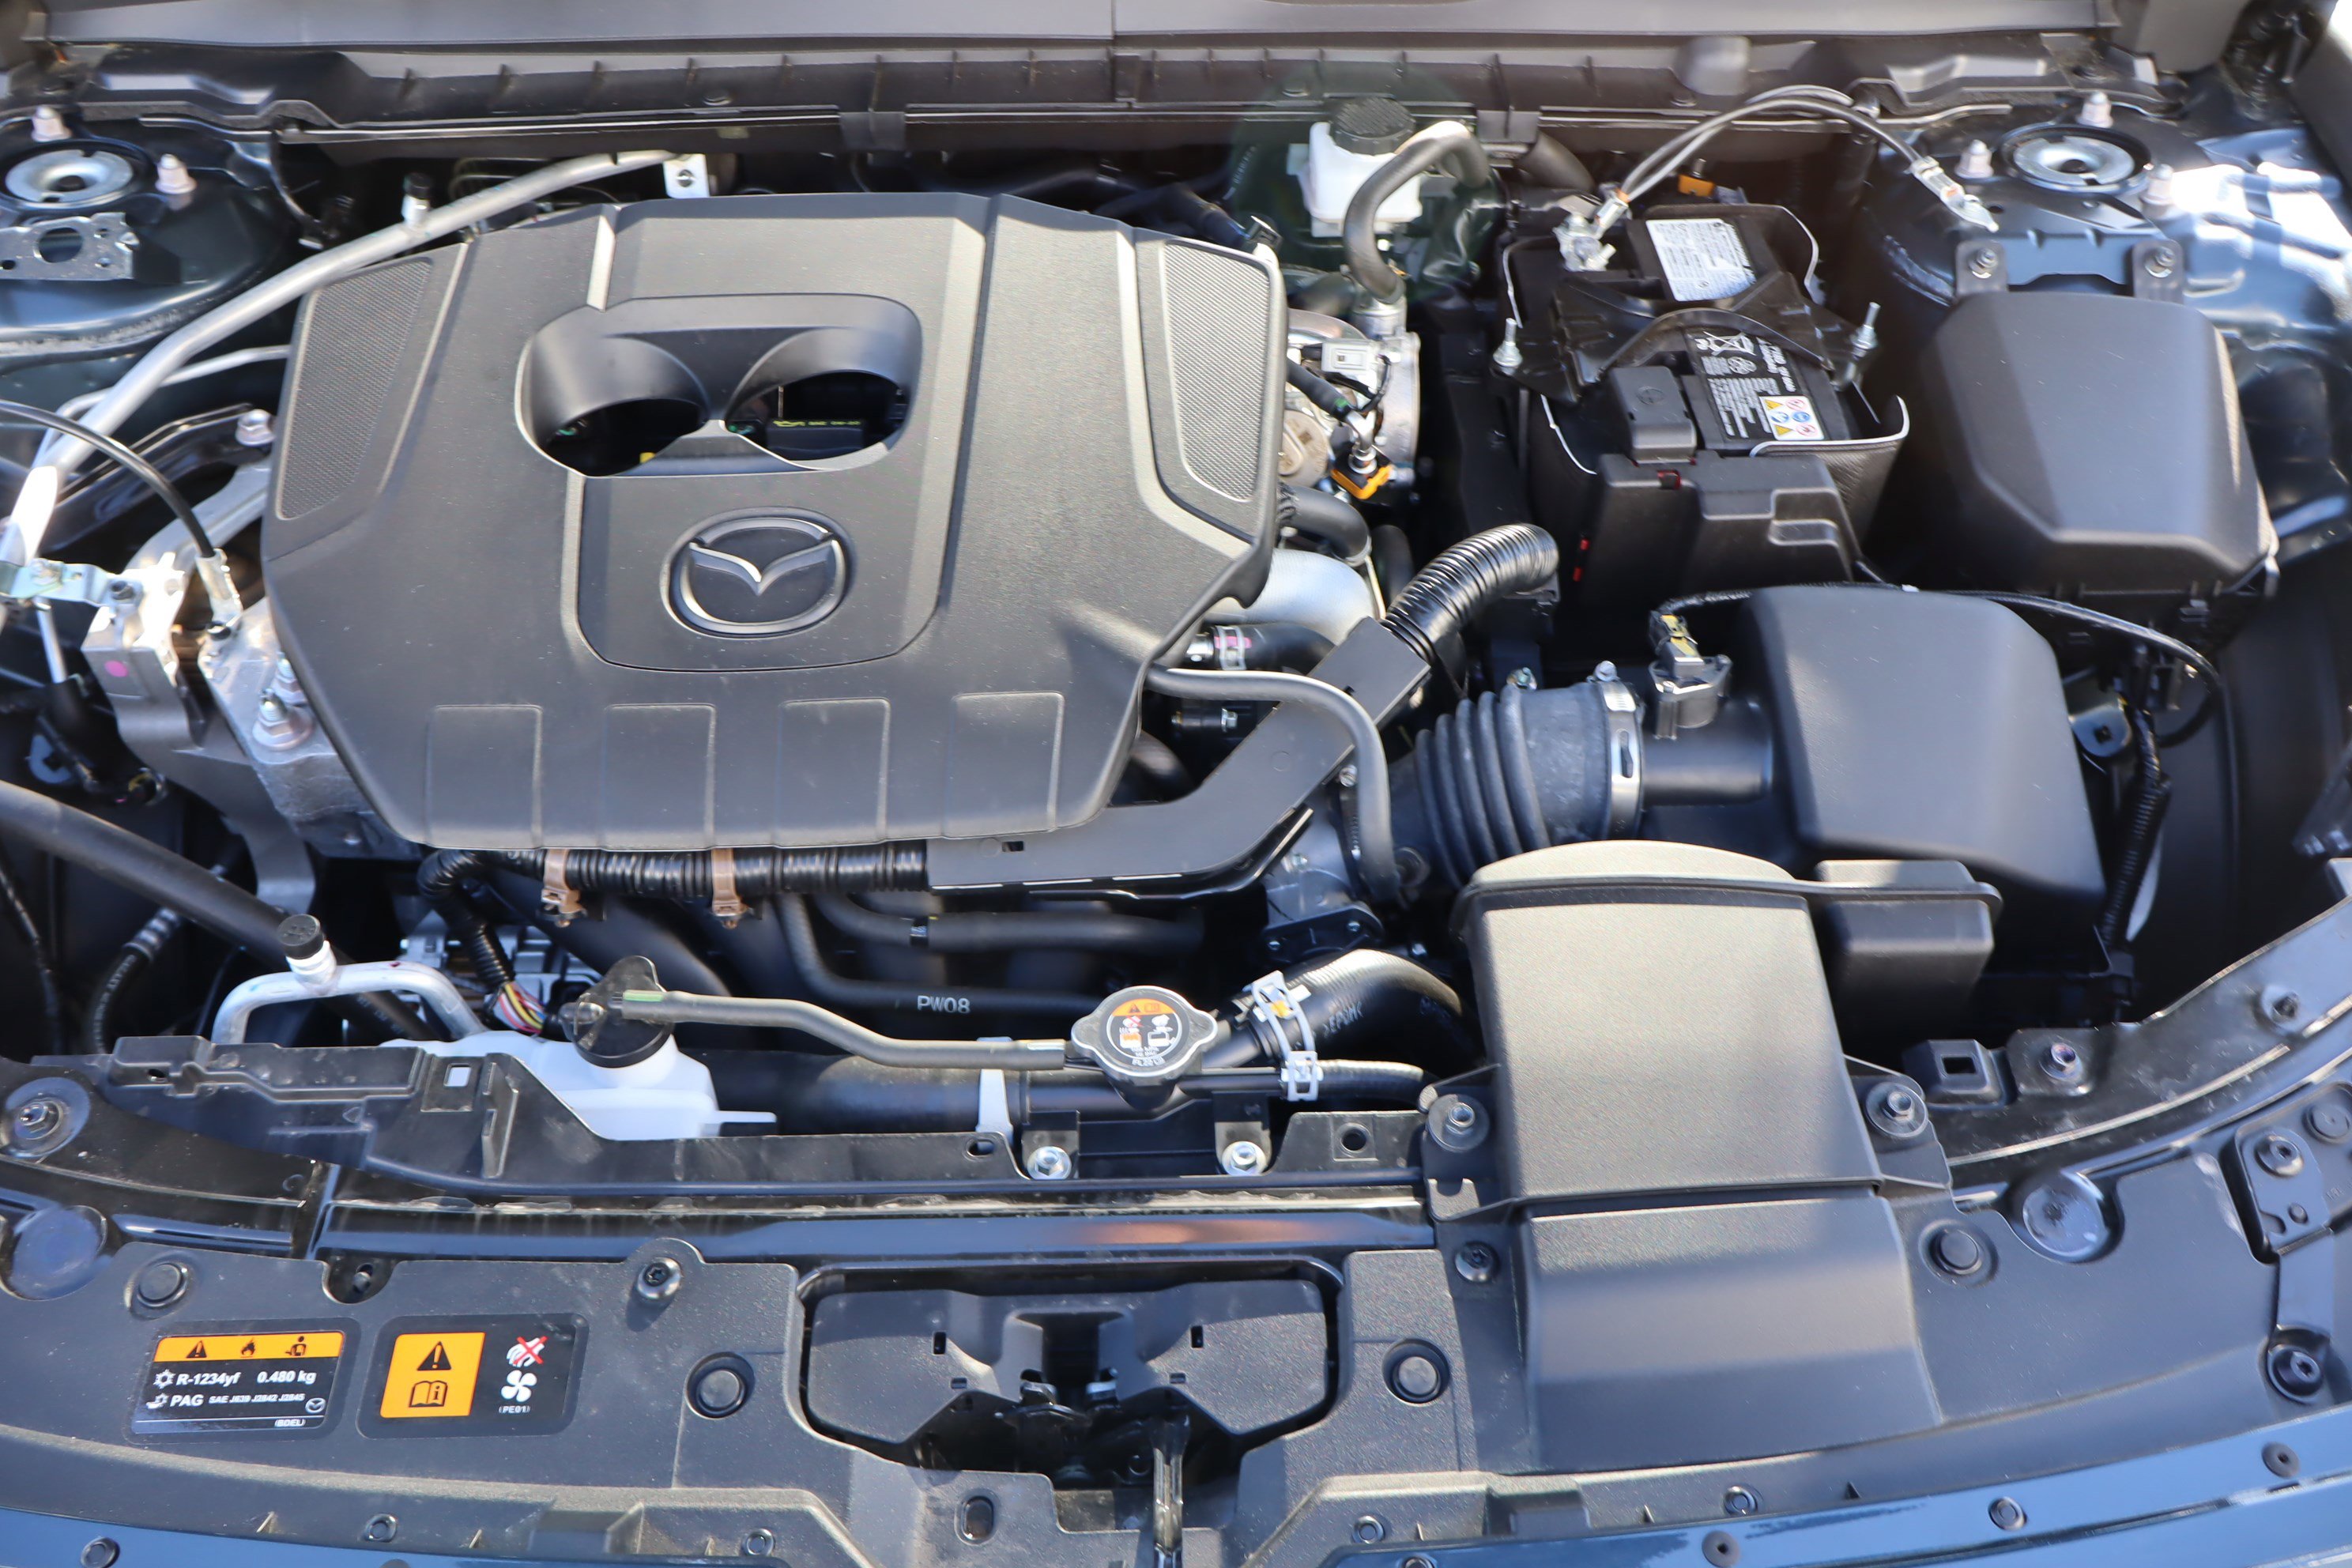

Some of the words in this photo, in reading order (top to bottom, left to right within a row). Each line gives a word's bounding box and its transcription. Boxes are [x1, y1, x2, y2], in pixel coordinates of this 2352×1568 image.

[917, 995, 971, 1014] PW08
[175, 1371, 241, 1387] R-1234yf
[257, 1370, 296, 1384] 0.480
[297, 1370, 317, 1385] kg
[169, 1394, 204, 1407] PAG
[209, 1395, 230, 1404] SAE
